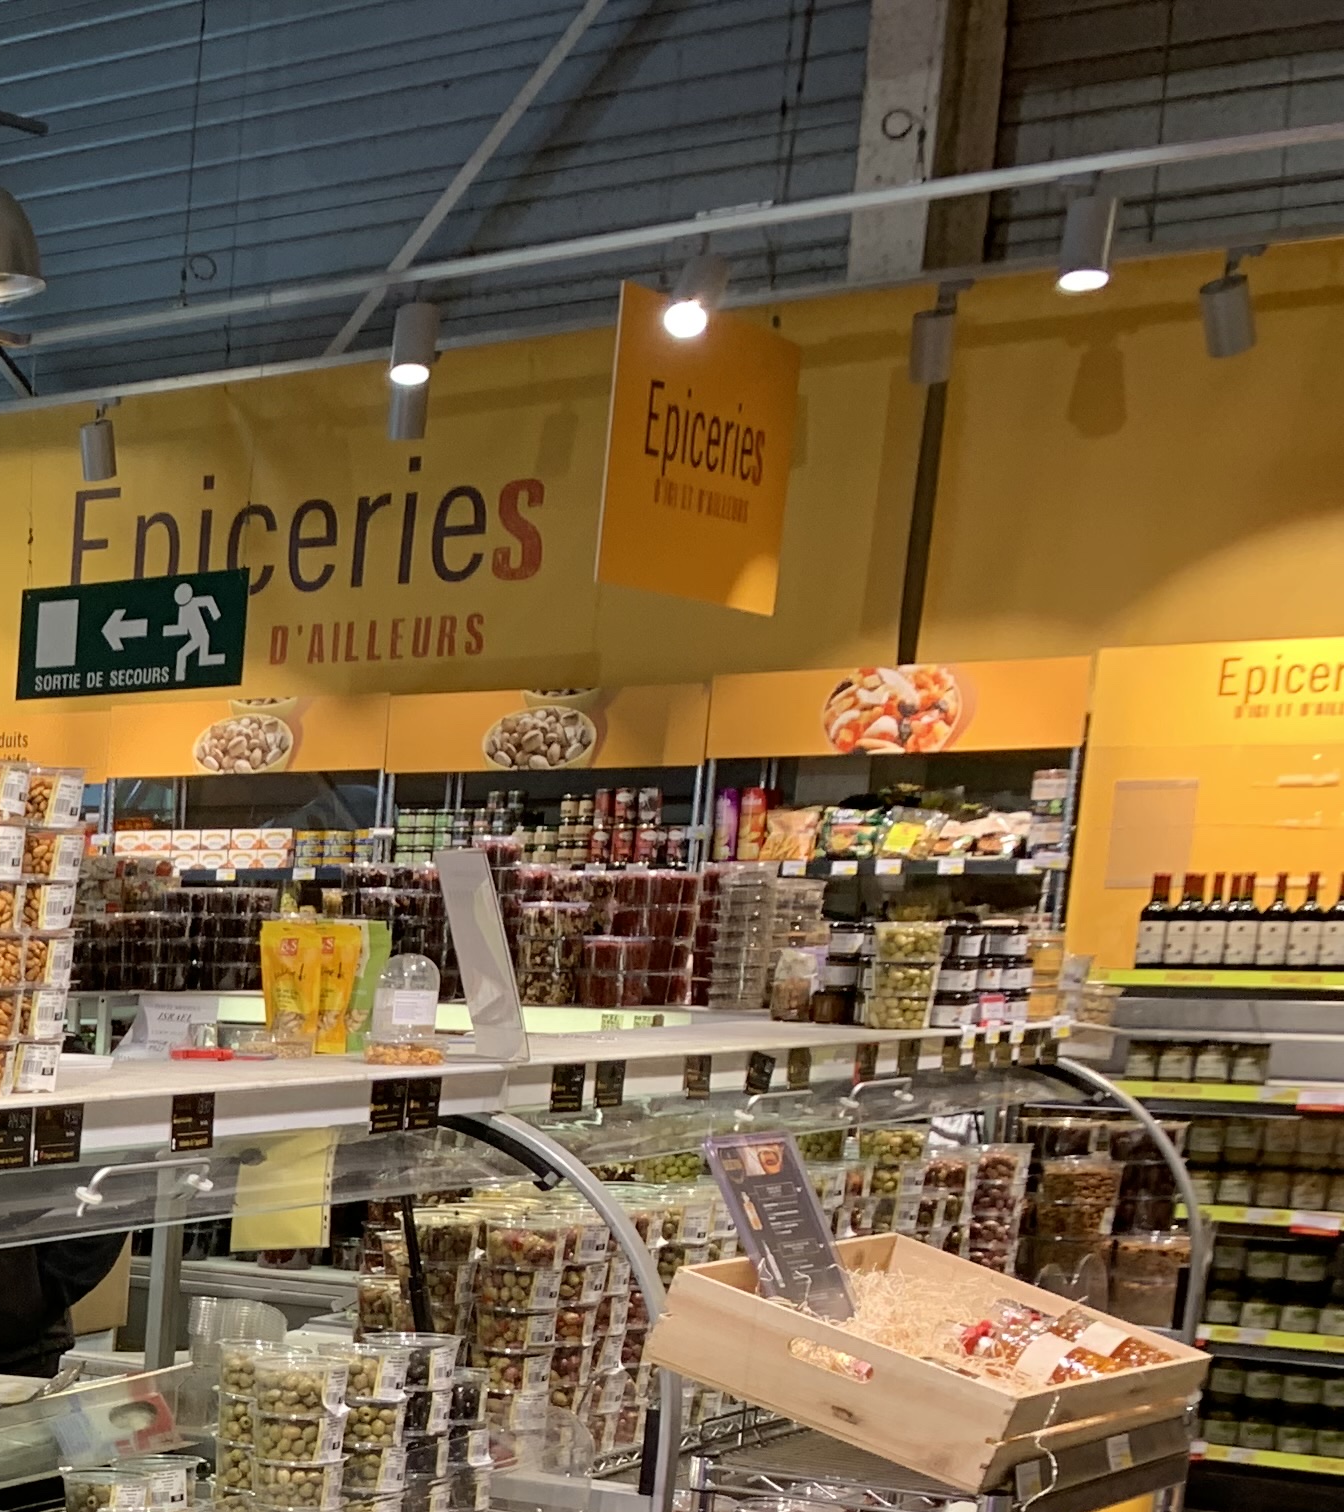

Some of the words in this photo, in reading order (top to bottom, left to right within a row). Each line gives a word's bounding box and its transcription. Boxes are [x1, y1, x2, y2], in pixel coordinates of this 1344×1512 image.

[645, 379, 765, 486] Epiceries
[269, 613, 485, 667] D'AILLEURS
[34, 672, 81, 691] SORTIE
[86, 671, 104, 688] DE
[109, 666, 170, 687] SECOURS
